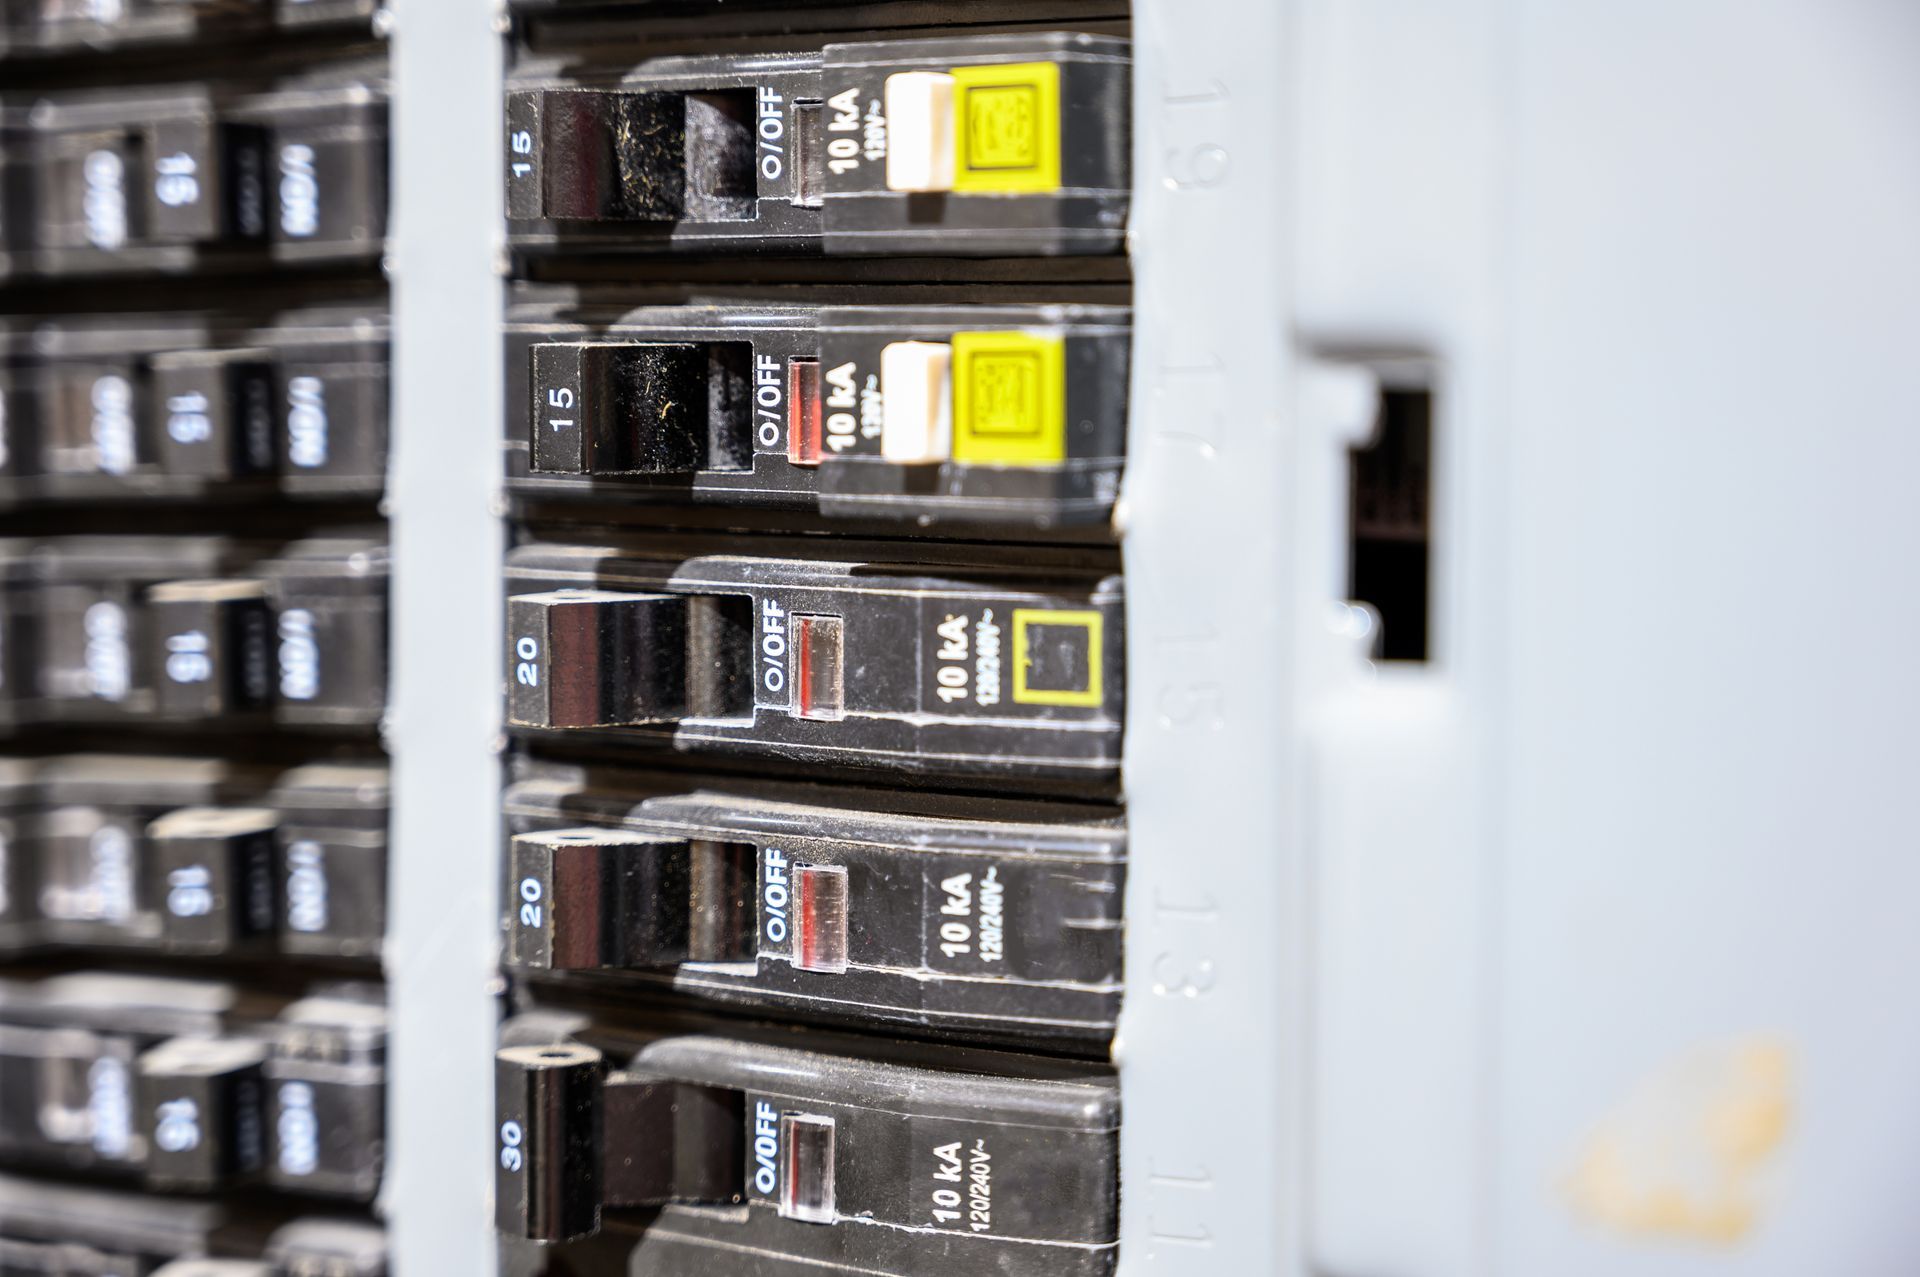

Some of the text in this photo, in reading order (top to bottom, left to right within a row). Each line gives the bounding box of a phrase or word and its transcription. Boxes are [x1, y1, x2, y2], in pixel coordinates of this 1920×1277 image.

[511, 130, 532, 178] 15
[759, 86, 784, 180] O/OFF
[828, 87, 861, 175] 10 kA
[1162, 77, 1231, 190] 19
[549, 387, 574, 432] 15
[757, 355, 781, 447] O/OFF
[826, 361, 857, 452] 10 kA
[517, 637, 537, 687] 20
[762, 599, 785, 692] O/OFF
[937, 614, 969, 703] 10 kA
[520, 878, 541, 928] 20
[765, 849, 788, 943] O/OFF
[940, 873, 972, 958] 10 kA
[1152, 886, 1219, 997] 13
[500, 1121, 522, 1173] 30
[755, 1102, 778, 1194] O/OFF
[932, 1142, 962, 1223] 10 kA
[1147, 1156, 1214, 1261] 11
